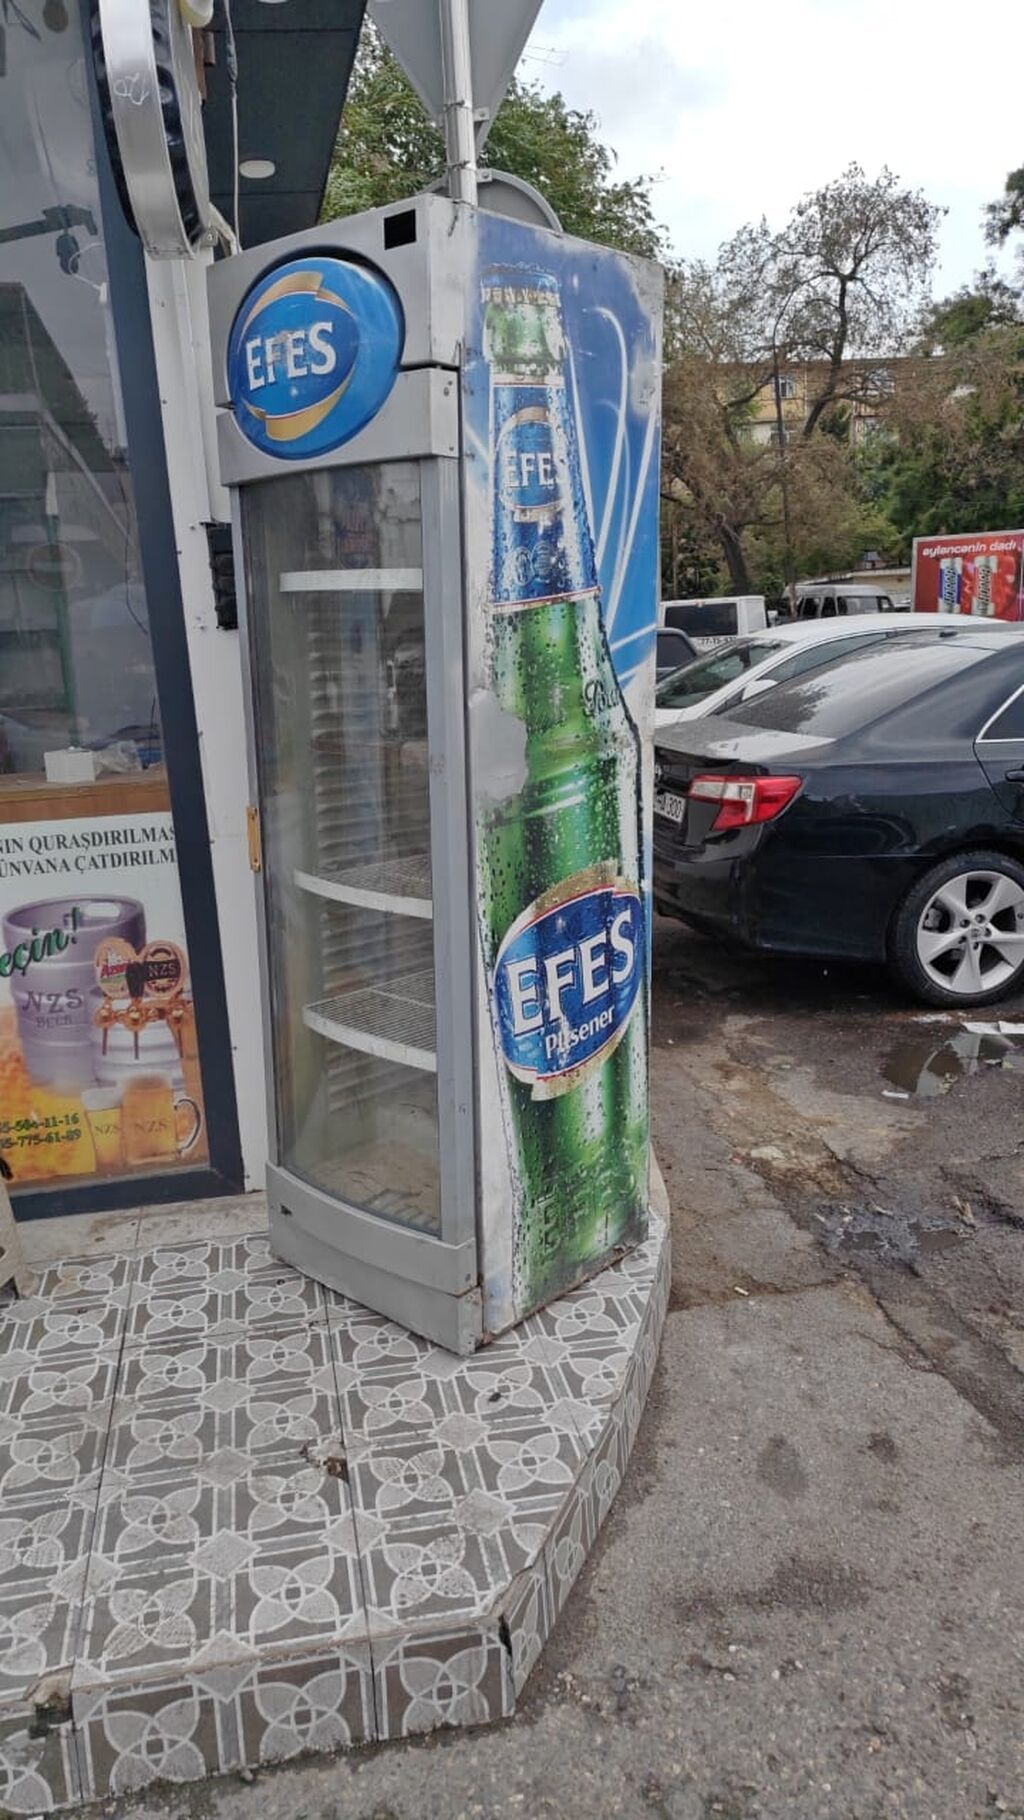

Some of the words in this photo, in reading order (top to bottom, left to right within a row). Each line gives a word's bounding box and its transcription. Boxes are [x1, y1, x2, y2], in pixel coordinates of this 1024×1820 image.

[246, 321, 336, 391] EFES
[147, 962, 178, 977] NZS
[506, 909, 636, 1037] EFES
[22, 987, 83, 1014] NZS
[545, 1005, 616, 1059] Pilsener
